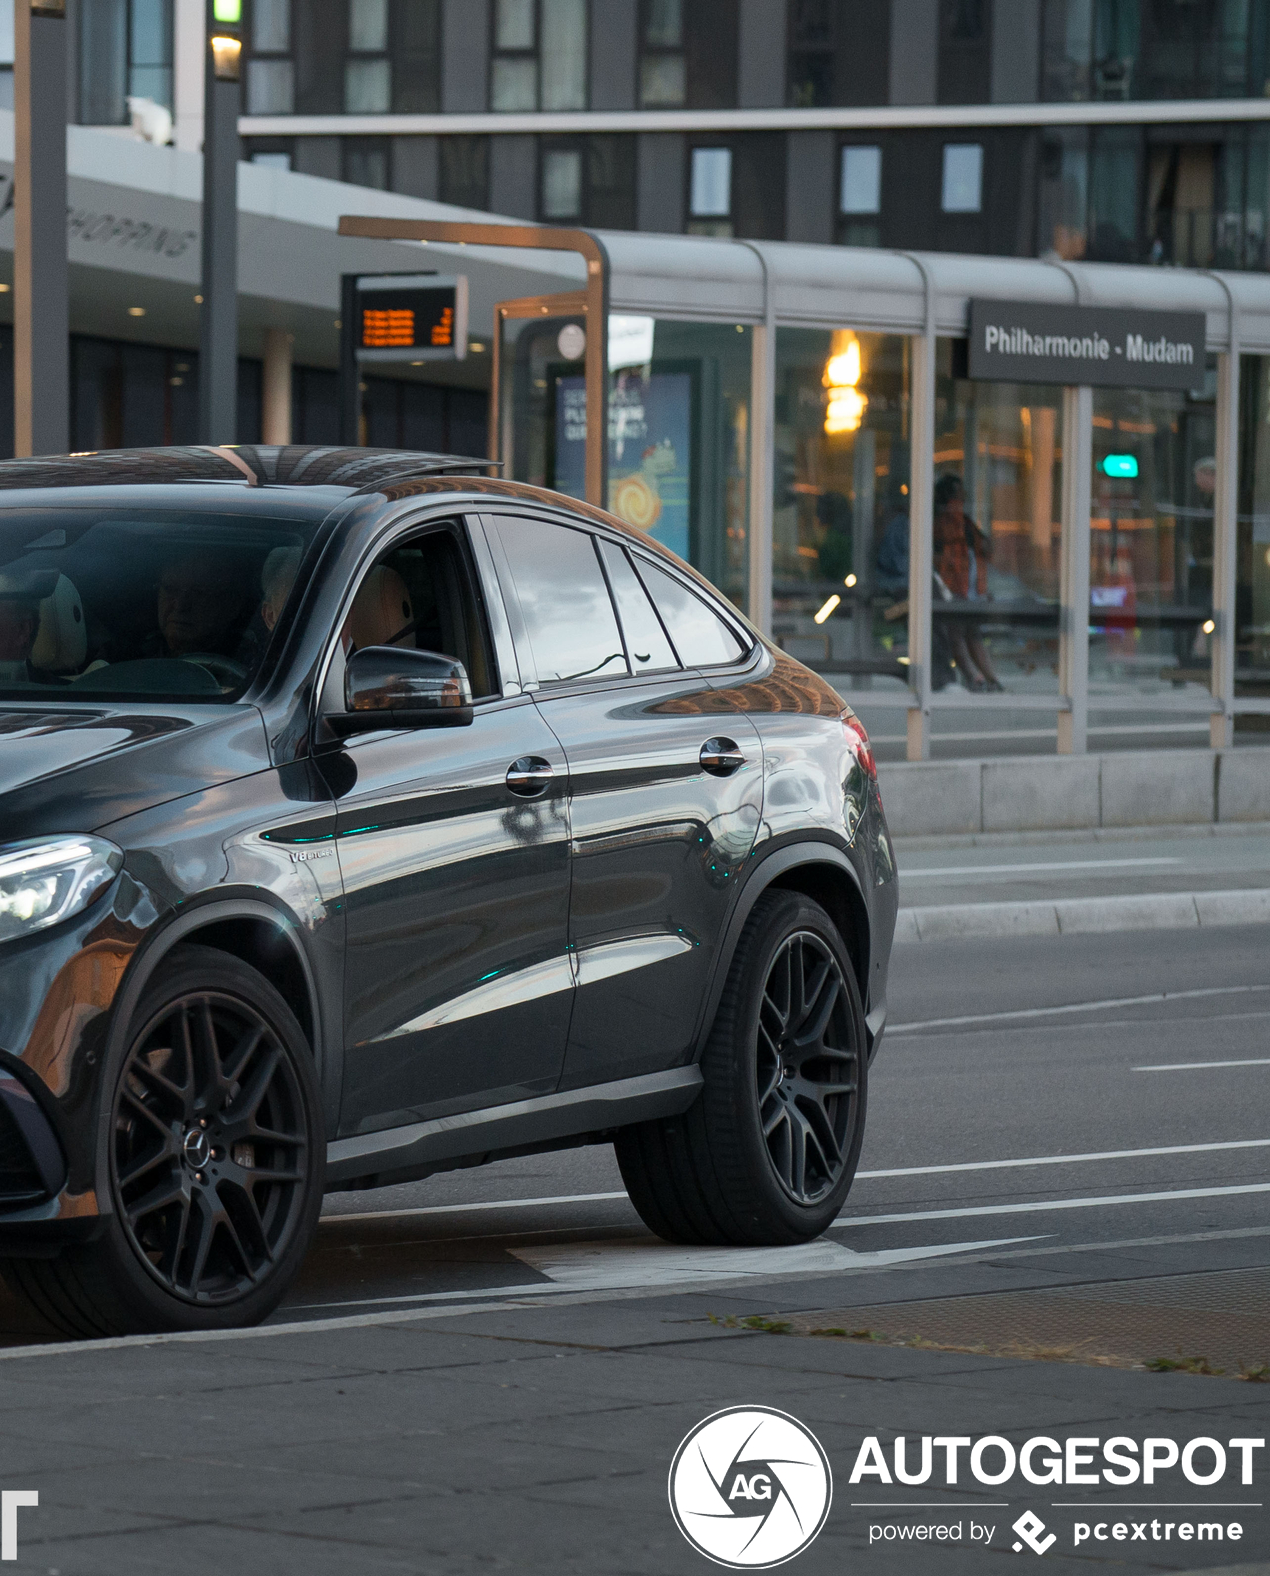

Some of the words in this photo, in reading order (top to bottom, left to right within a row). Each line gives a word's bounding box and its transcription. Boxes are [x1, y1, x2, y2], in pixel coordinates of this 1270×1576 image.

[66, 204, 198, 259] HOPPING
[985, 325, 1110, 360] Philharmonie
[1126, 333, 1193, 364] Mudam
[289, 851, 307, 863] V8
